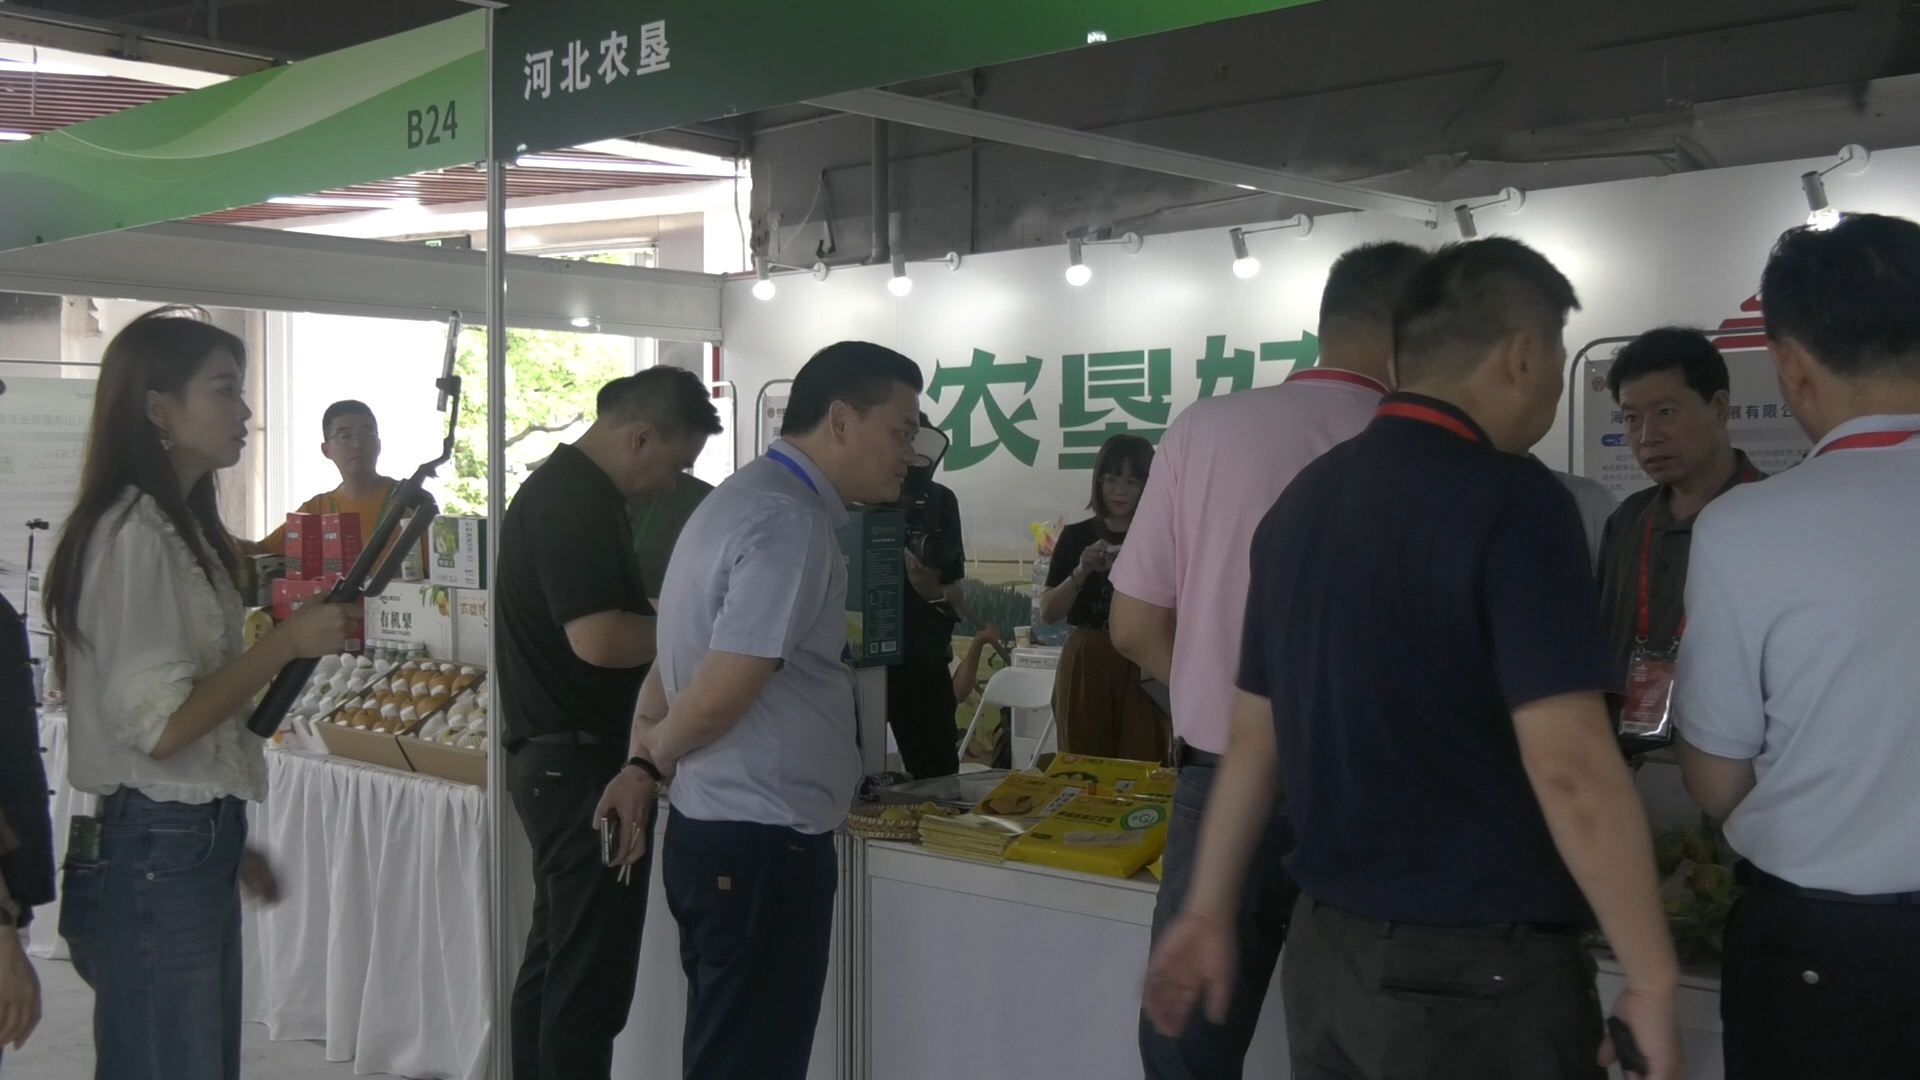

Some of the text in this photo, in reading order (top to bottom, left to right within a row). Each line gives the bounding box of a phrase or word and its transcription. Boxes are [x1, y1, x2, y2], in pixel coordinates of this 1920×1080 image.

[524, 20, 671, 100] 河北农垦
[407, 100, 458, 149] B24
[381, 610, 412, 630] 有机梨
